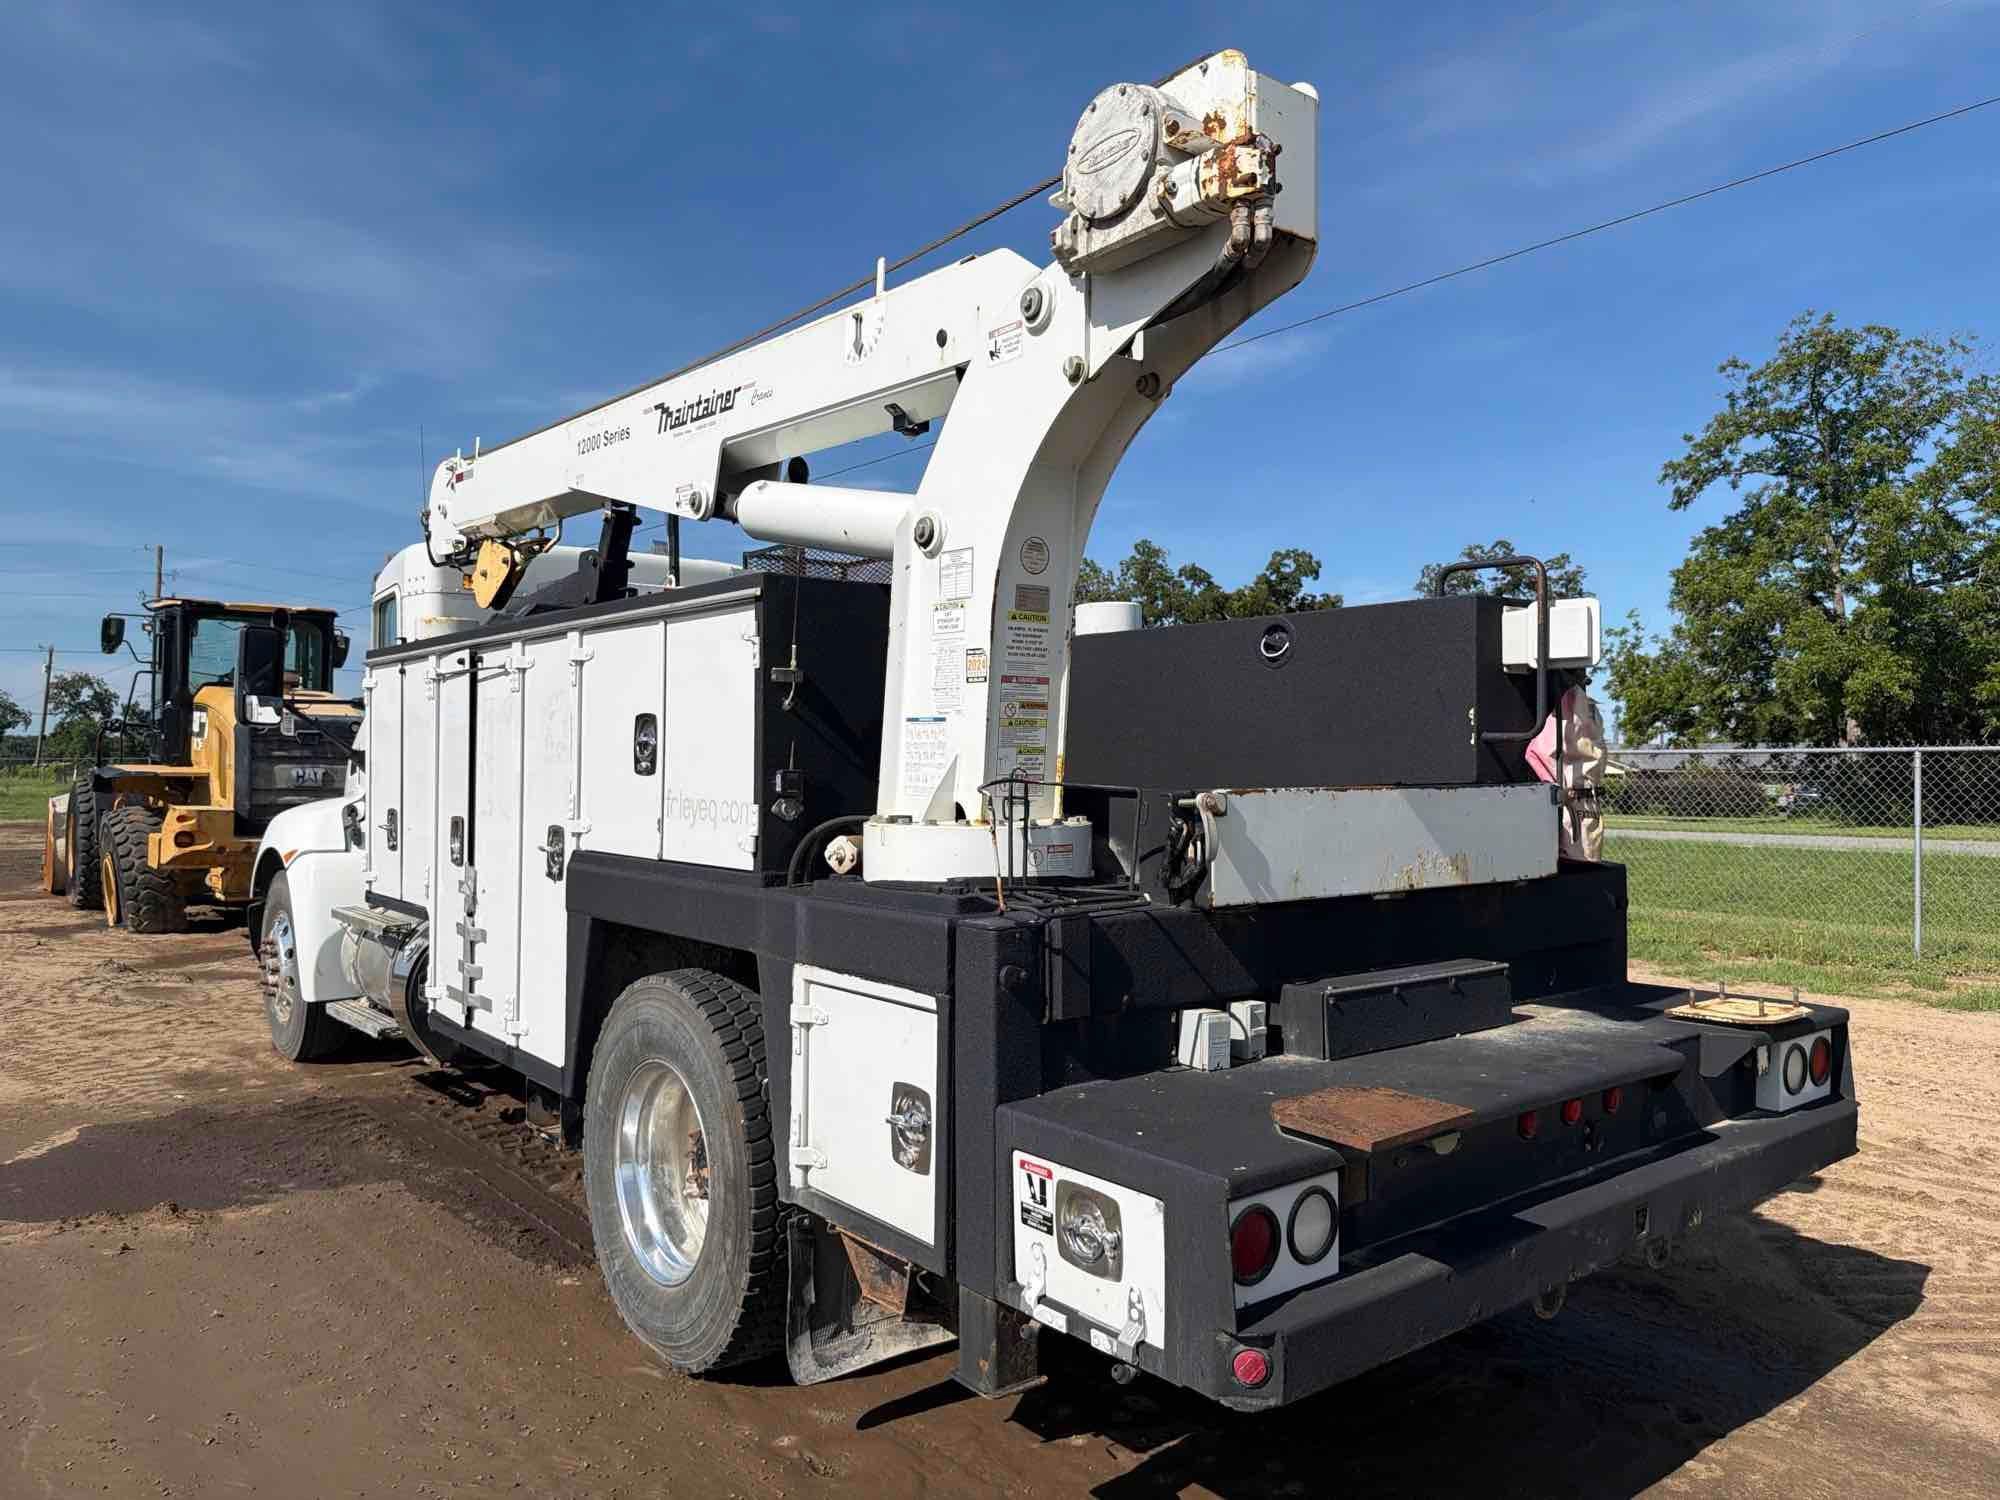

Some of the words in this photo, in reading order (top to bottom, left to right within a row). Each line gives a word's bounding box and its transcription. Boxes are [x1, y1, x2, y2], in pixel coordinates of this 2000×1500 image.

[653, 386, 741, 434] Maintainer
[577, 433, 601, 456] 12000
[603, 426, 631, 447] Series
[1018, 614, 1047, 623] CAUTION
